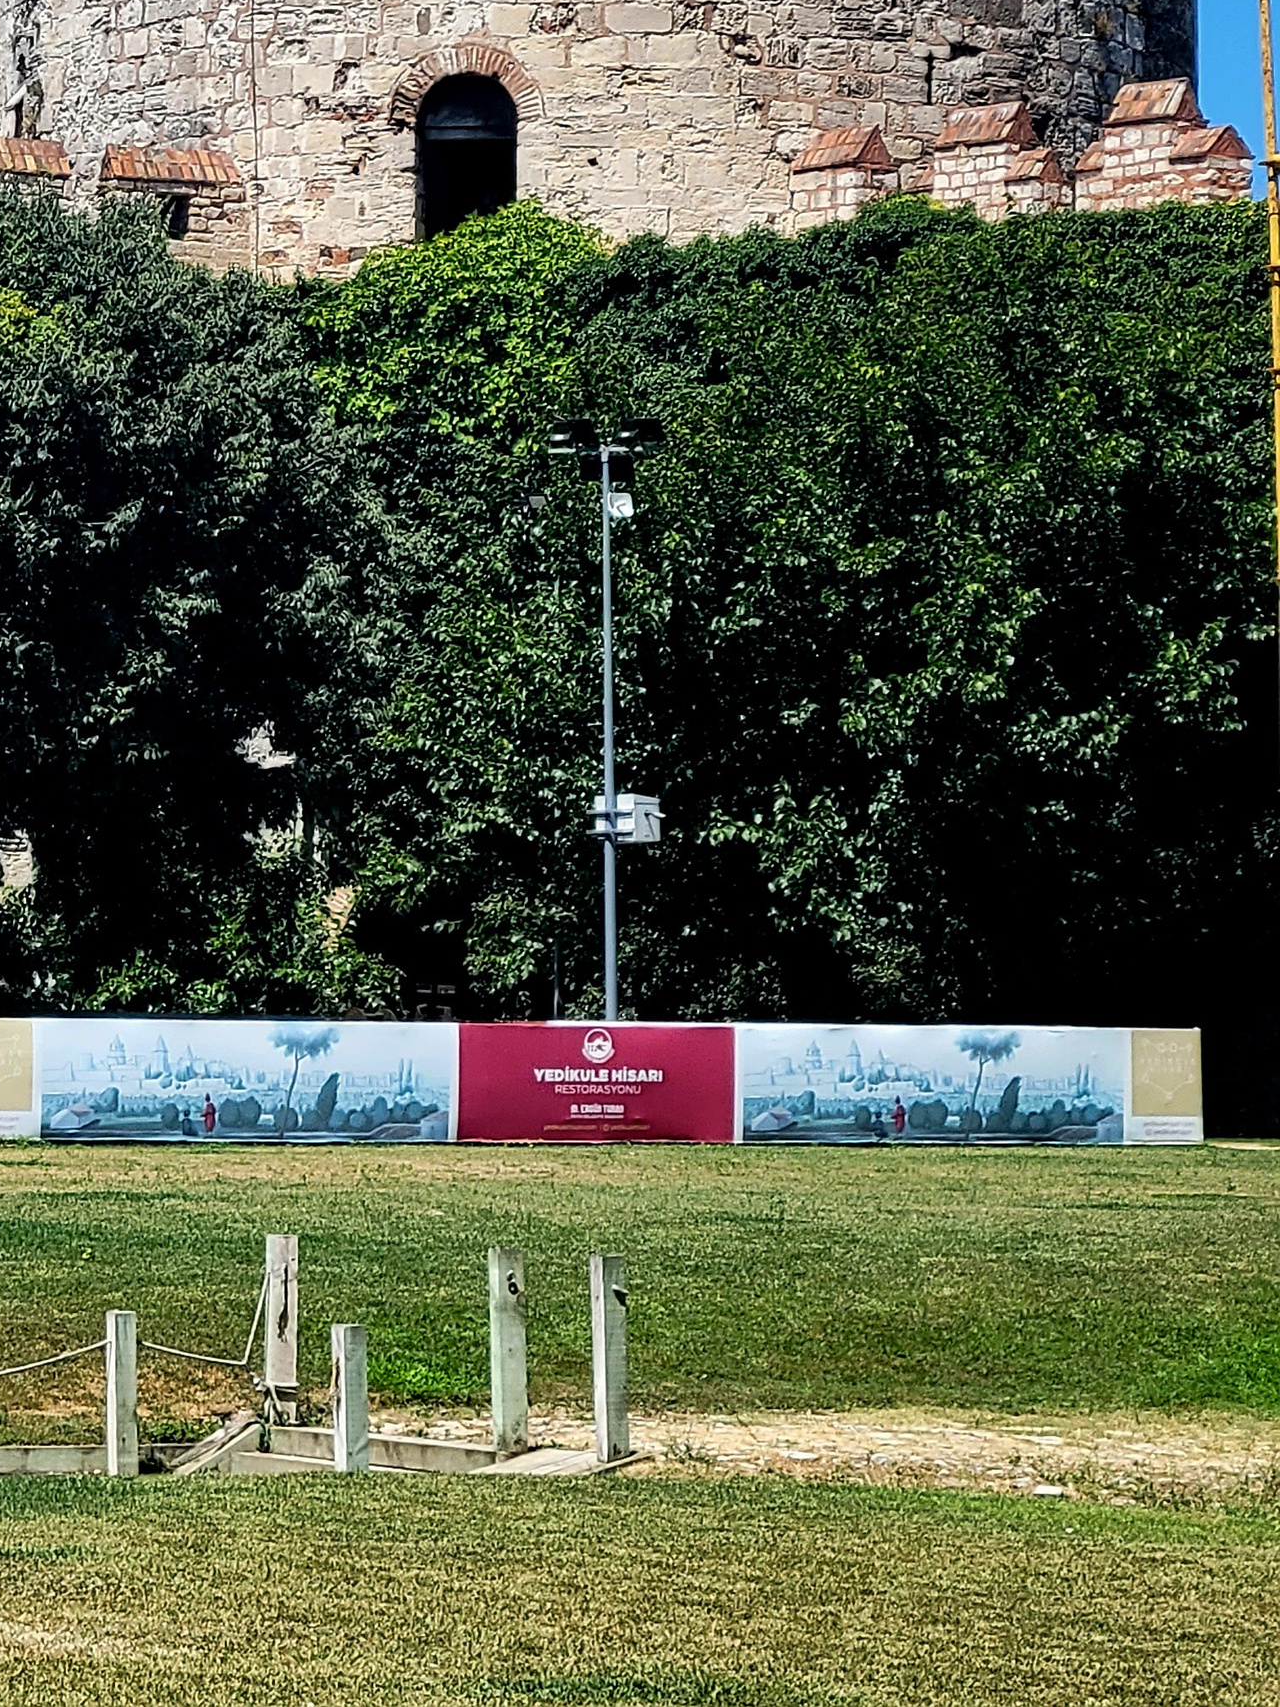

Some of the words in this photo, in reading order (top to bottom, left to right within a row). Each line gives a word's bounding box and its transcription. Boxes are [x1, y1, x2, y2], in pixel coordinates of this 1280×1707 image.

[533, 1065, 609, 1082] YEDİKULE
[611, 1065, 663, 1082] HİSARI
[554, 1084, 641, 1094] RESTORASYONU
